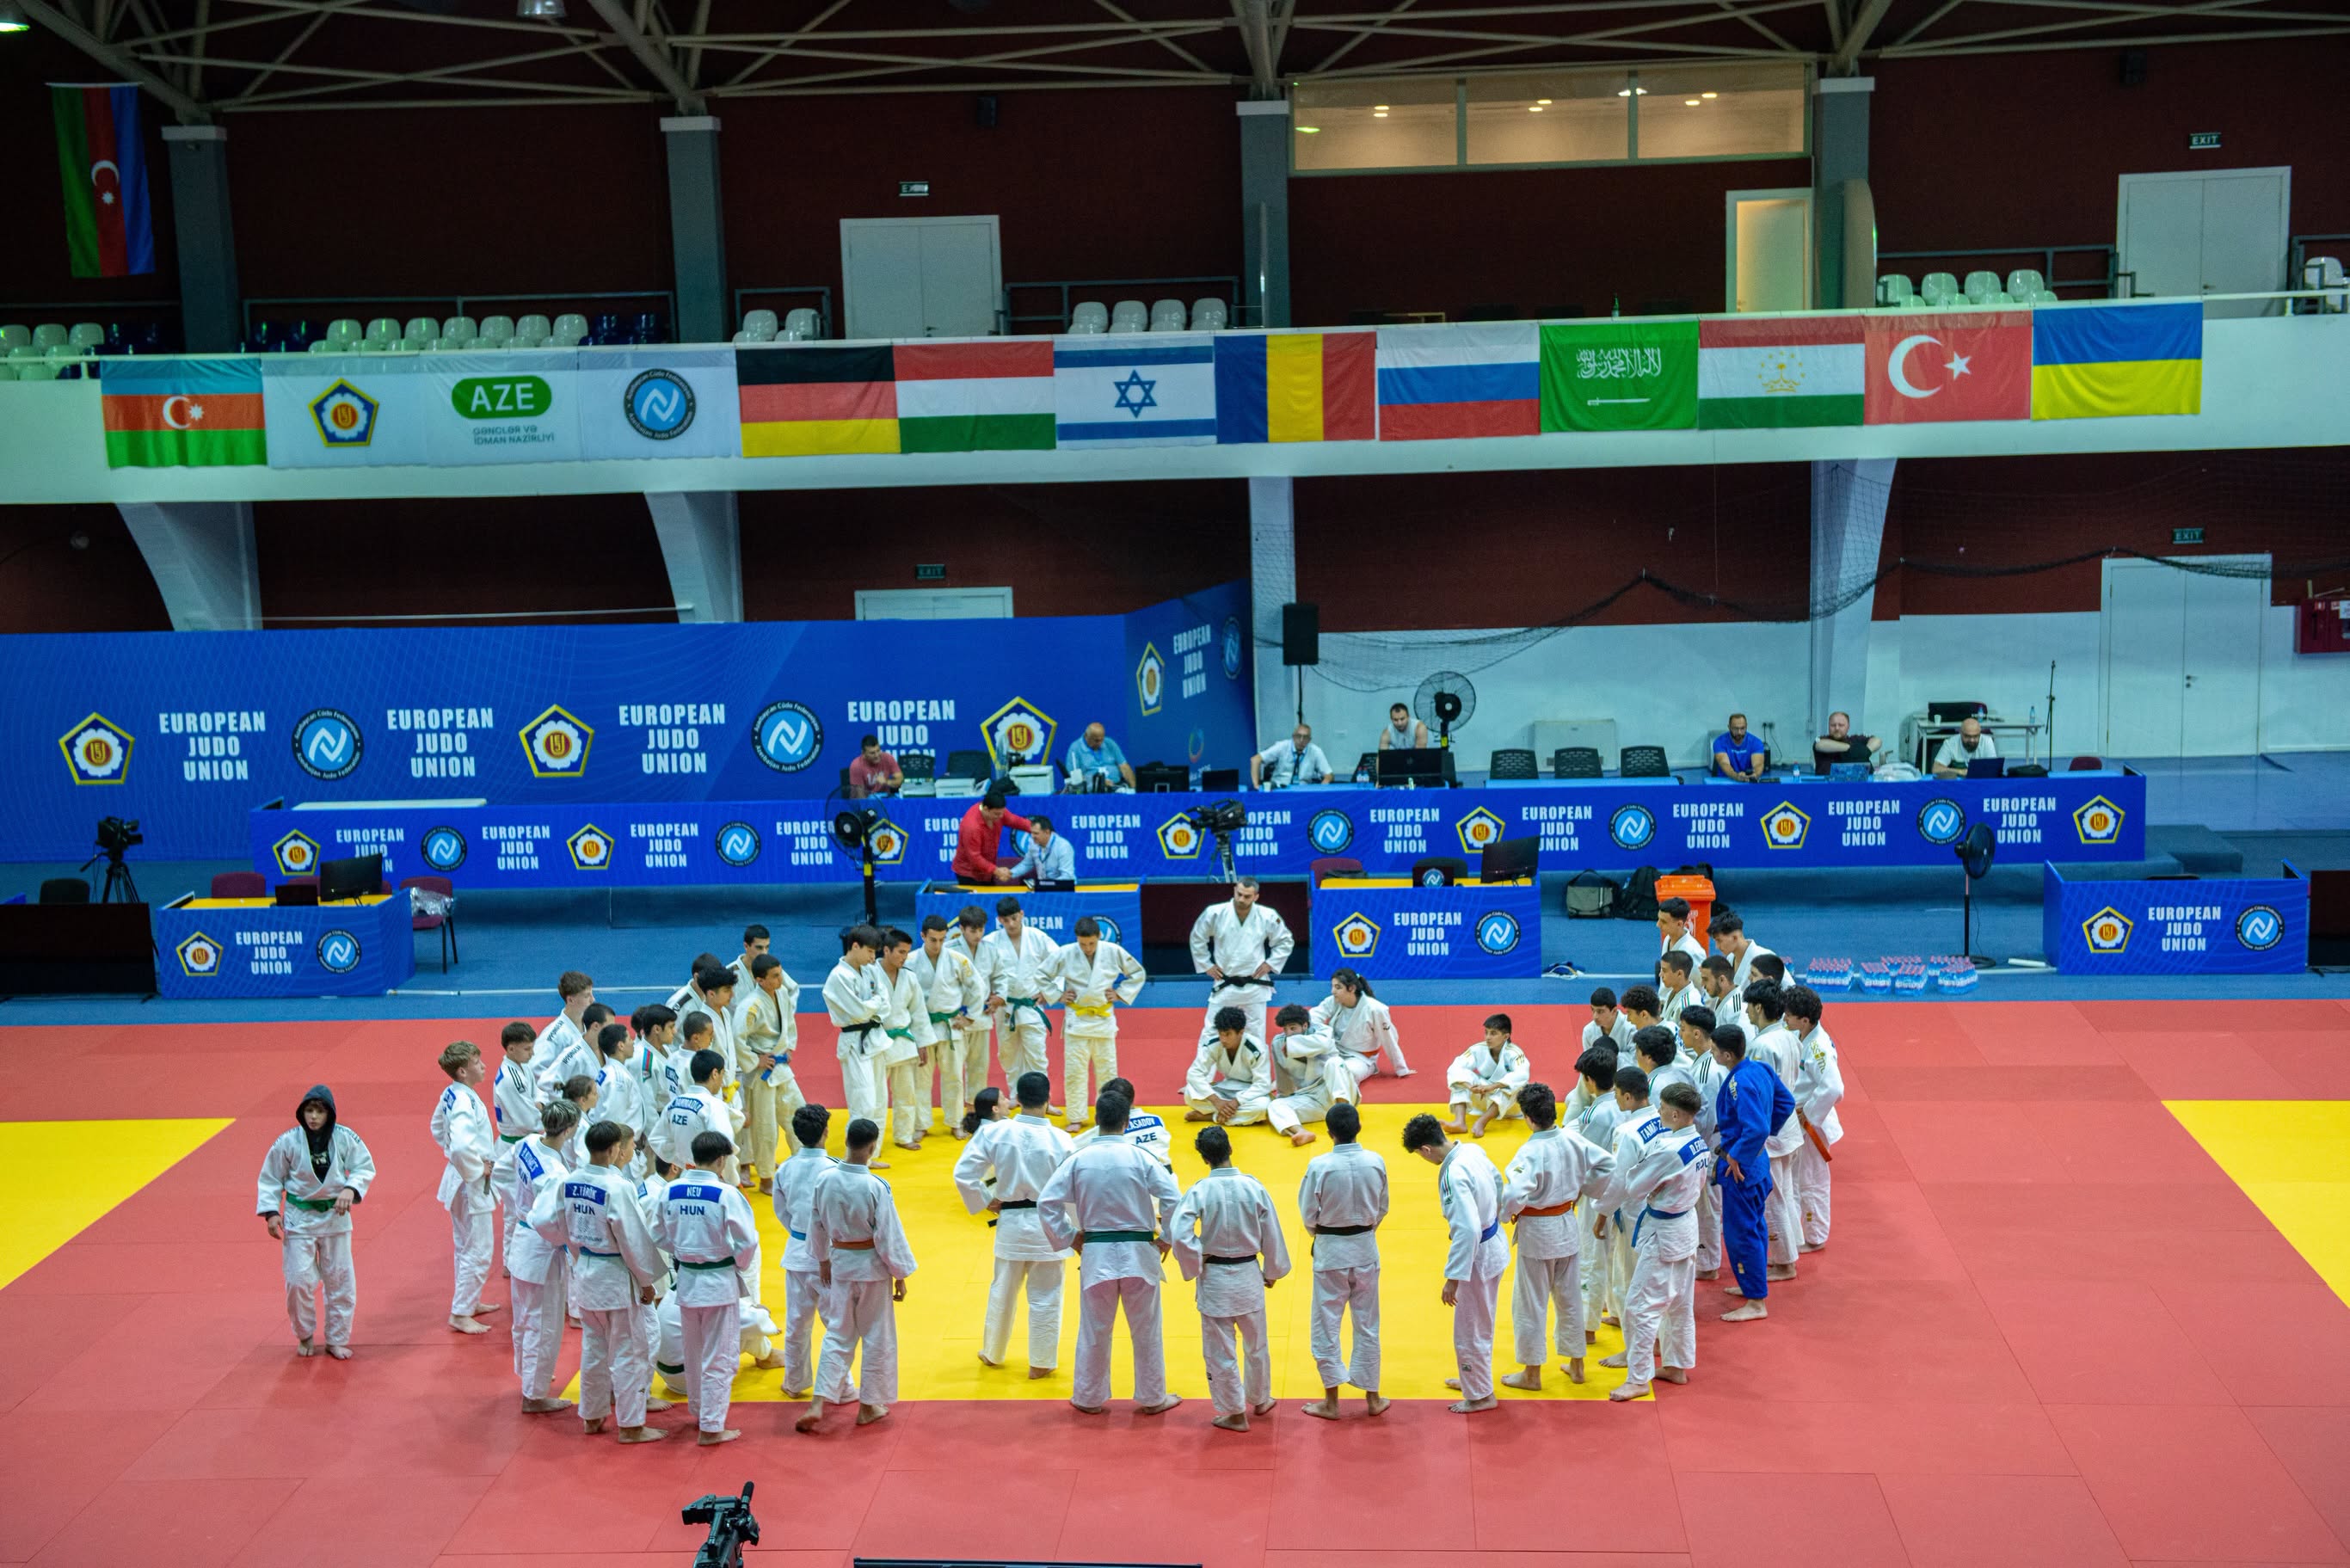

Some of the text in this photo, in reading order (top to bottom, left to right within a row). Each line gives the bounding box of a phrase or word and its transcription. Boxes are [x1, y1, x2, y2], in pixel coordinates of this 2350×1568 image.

[2192, 136, 2218, 145] EXIT
[471, 383, 534, 412] AZE
[1173, 624, 1211, 655] EUROPEAN
[1184, 650, 1203, 674] JUDO
[1183, 673, 1206, 698] UNION
[619, 704, 725, 725] EUROPEAN
[848, 700, 955, 722] EUROPEAN
[160, 711, 266, 733] EUROPEAN
[388, 708, 493, 729] EUROPEAN
[648, 729, 698, 749] JUDO
[877, 724, 928, 746] JUDO
[188, 736, 240, 757] JUDO
[416, 733, 467, 753] JUDO
[411, 757, 475, 778] UNION
[643, 753, 706, 773] UNION
[183, 760, 248, 781] UNION
[1673, 803, 1744, 817] EUROPEAN
[1828, 801, 1900, 815] EUROPEAN
[1984, 797, 2056, 812] EUROPEAN
[1248, 811, 1291, 825] OPEAN
[1370, 808, 1439, 822] EUROPEAN
[1522, 806, 1592, 821] EUROPEAN
[2002, 814, 2037, 827] JUDO
[777, 821, 835, 835] EUROPEA
[925, 818, 961, 832] EURO
[1072, 815, 1141, 829] EUROPEAN
[1540, 821, 1574, 835] JUDO
[1691, 819, 1725, 833] JUDO
[1846, 817, 1881, 830] JUDO
[336, 828, 404, 843] EUROPEAN
[482, 826, 551, 839] EUROPEAN
[631, 823, 698, 837] EUROPEAN
[1090, 830, 1123, 844] JUDO
[1388, 824, 1422, 837] JUDO
[1997, 829, 2041, 843] UNION
[649, 839, 682, 852] JUDO
[795, 836, 827, 850] JUDO
[943, 833, 957, 847] JU
[1384, 839, 1426, 852] UNION
[1687, 834, 1729, 848] UNION
[1842, 833, 1886, 845] UNION
[501, 841, 533, 854] JUDO
[1086, 845, 1129, 859] UNION
[1235, 842, 1278, 856] UNION
[497, 857, 538, 870] UNION
[645, 854, 687, 868] UNION
[791, 852, 833, 865] UNION
[1393, 912, 1461, 926] EUROPEAN
[2148, 907, 2221, 921] EUROPEAN
[1412, 927, 1445, 941] JUDO
[2166, 922, 2201, 936] JUDO
[236, 932, 303, 945] EUROPEAN
[2162, 938, 2206, 951] UNION
[255, 946, 286, 960] JUDO
[1407, 943, 1449, 956] UNION
[250, 962, 292, 975] UNION
[672, 1114, 688, 1126] AZE
[1126, 1117, 1155, 1130] .ASADOV
[1135, 1132, 1158, 1144] AZE
[686, 1186, 703, 1198] NEU
[574, 1203, 595, 1216] HUN
[680, 1205, 704, 1215] HUN
